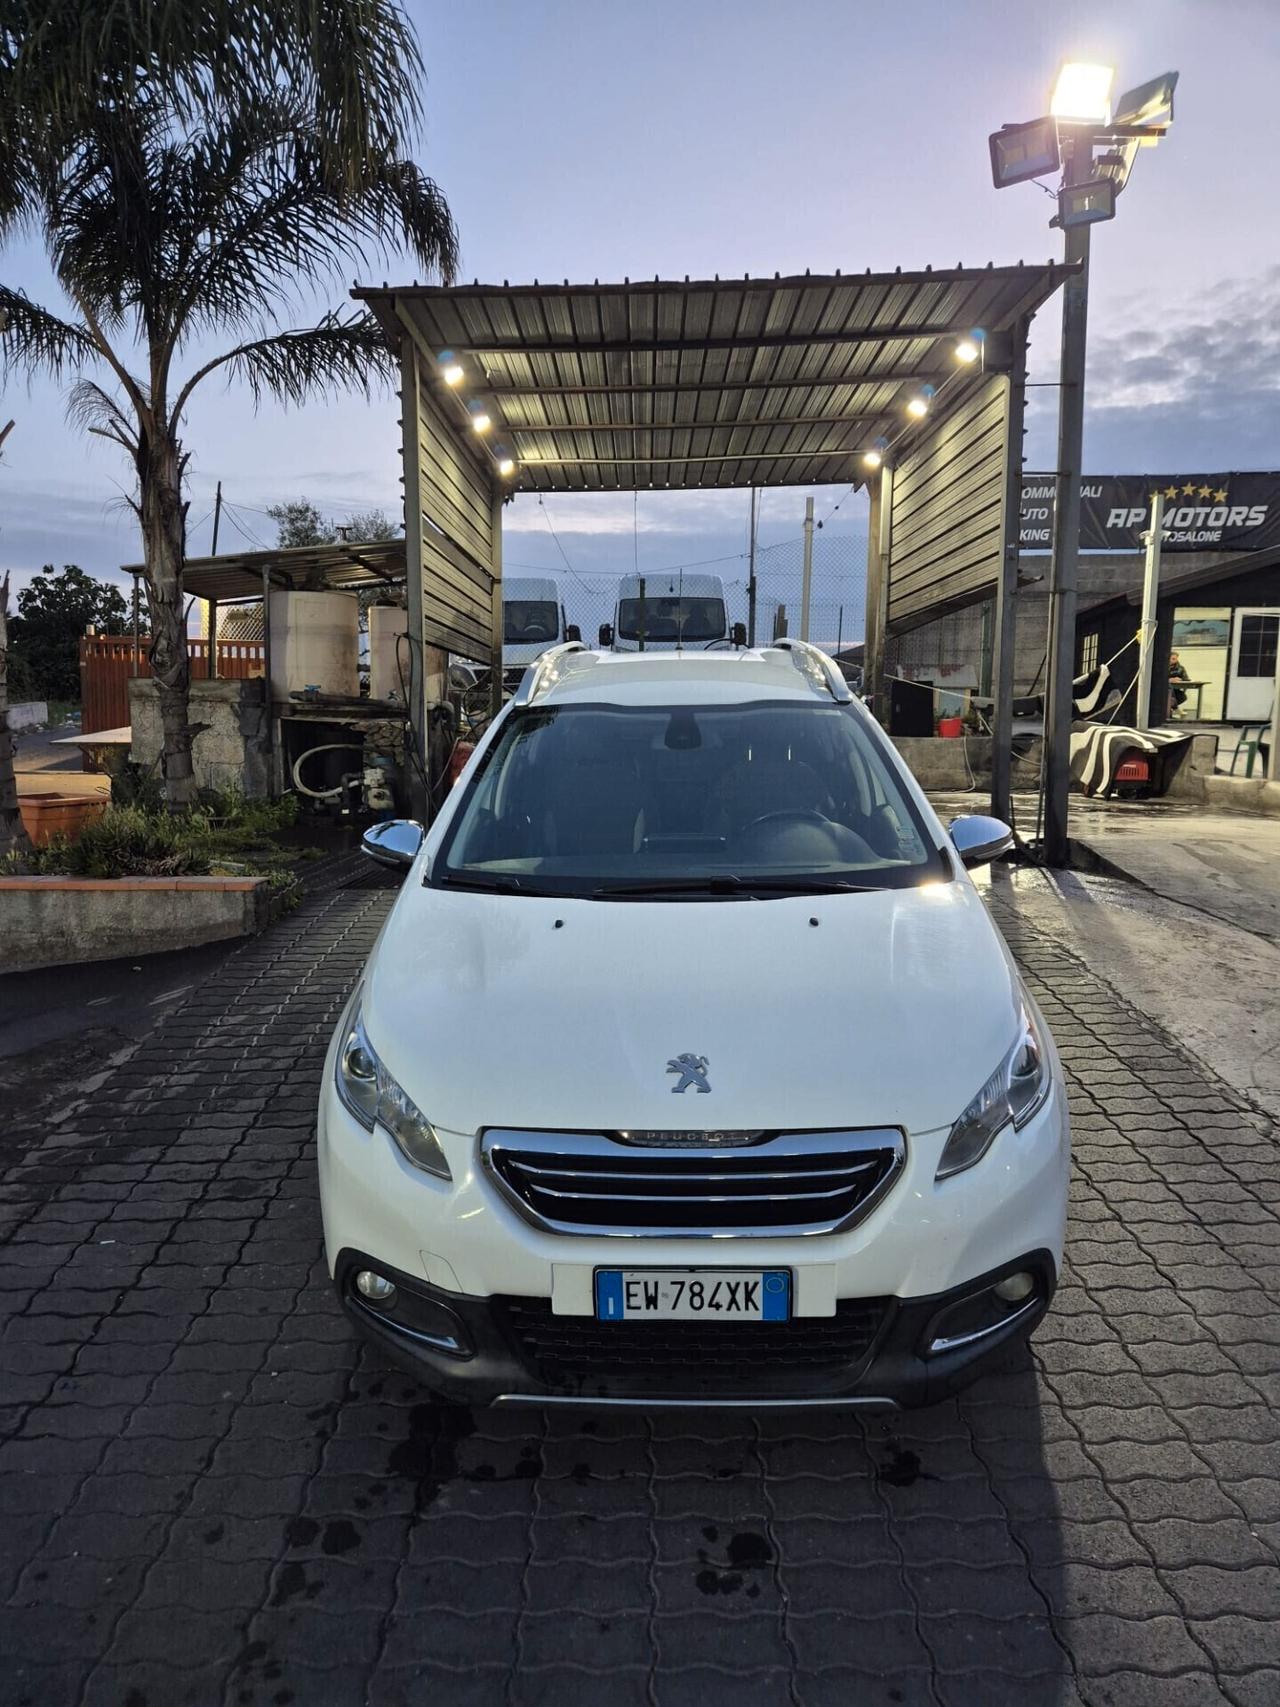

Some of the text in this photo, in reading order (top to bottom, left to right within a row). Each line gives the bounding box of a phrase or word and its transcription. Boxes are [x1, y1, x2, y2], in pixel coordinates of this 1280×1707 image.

[1022, 507, 1049, 520] UTO
[1106, 507, 1147, 529] AP
[625, 1281, 760, 1312] EW 784XK
